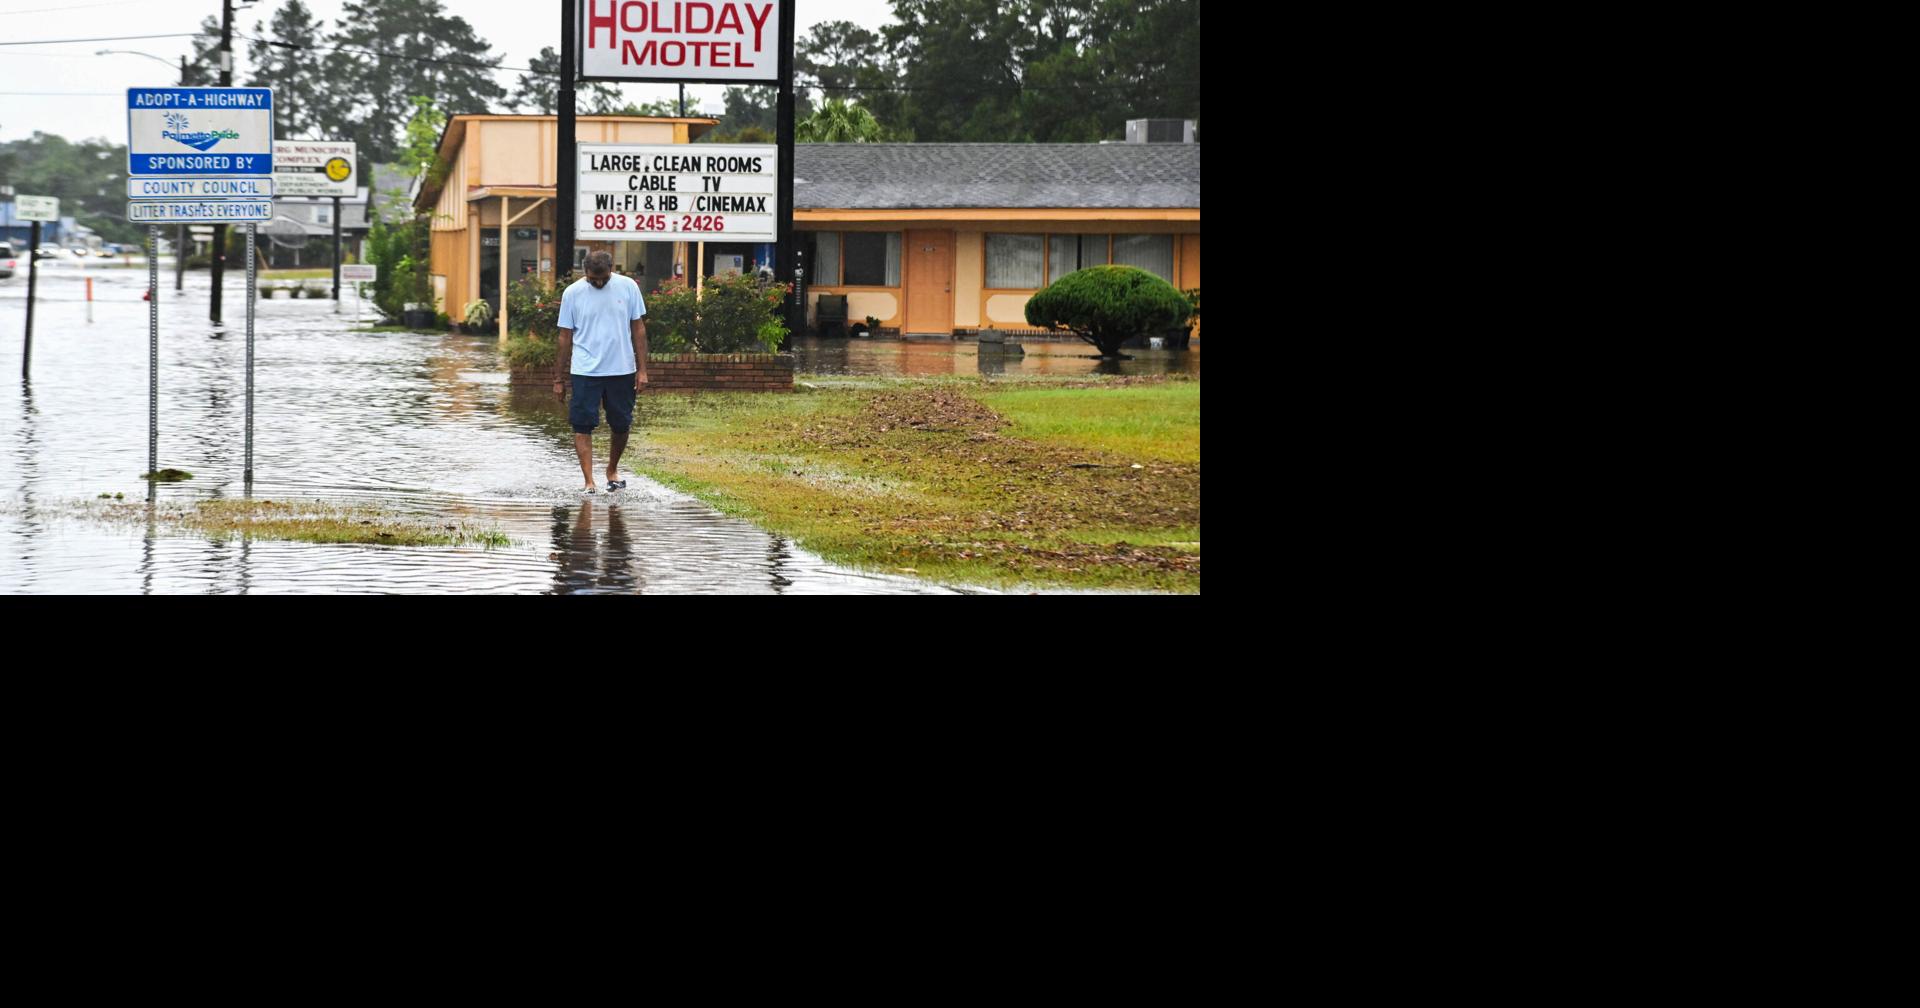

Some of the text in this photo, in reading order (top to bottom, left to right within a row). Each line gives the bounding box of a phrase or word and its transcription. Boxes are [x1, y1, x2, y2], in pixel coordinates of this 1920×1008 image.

[588, 0, 773, 52] HOLIDAY
[621, 39, 754, 68] MOTEL
[136, 93, 264, 107] ADOPT-A-HIGHWAY
[149, 156, 254, 170] SPONSORED BY
[653, 155, 701, 172] CLEAN
[706, 156, 762, 173] ROOMS
[143, 181, 195, 194] COUNTY
[202, 181, 260, 194] COUNCIL
[628, 174, 721, 192] CABLE TV
[133, 203, 269, 218] LITTER TRASHES EVERYONE
[595, 193, 638, 212] WI-FI
[643, 194, 655, 210] &
[658, 195, 679, 211] HB
[593, 213, 626, 230] 803
